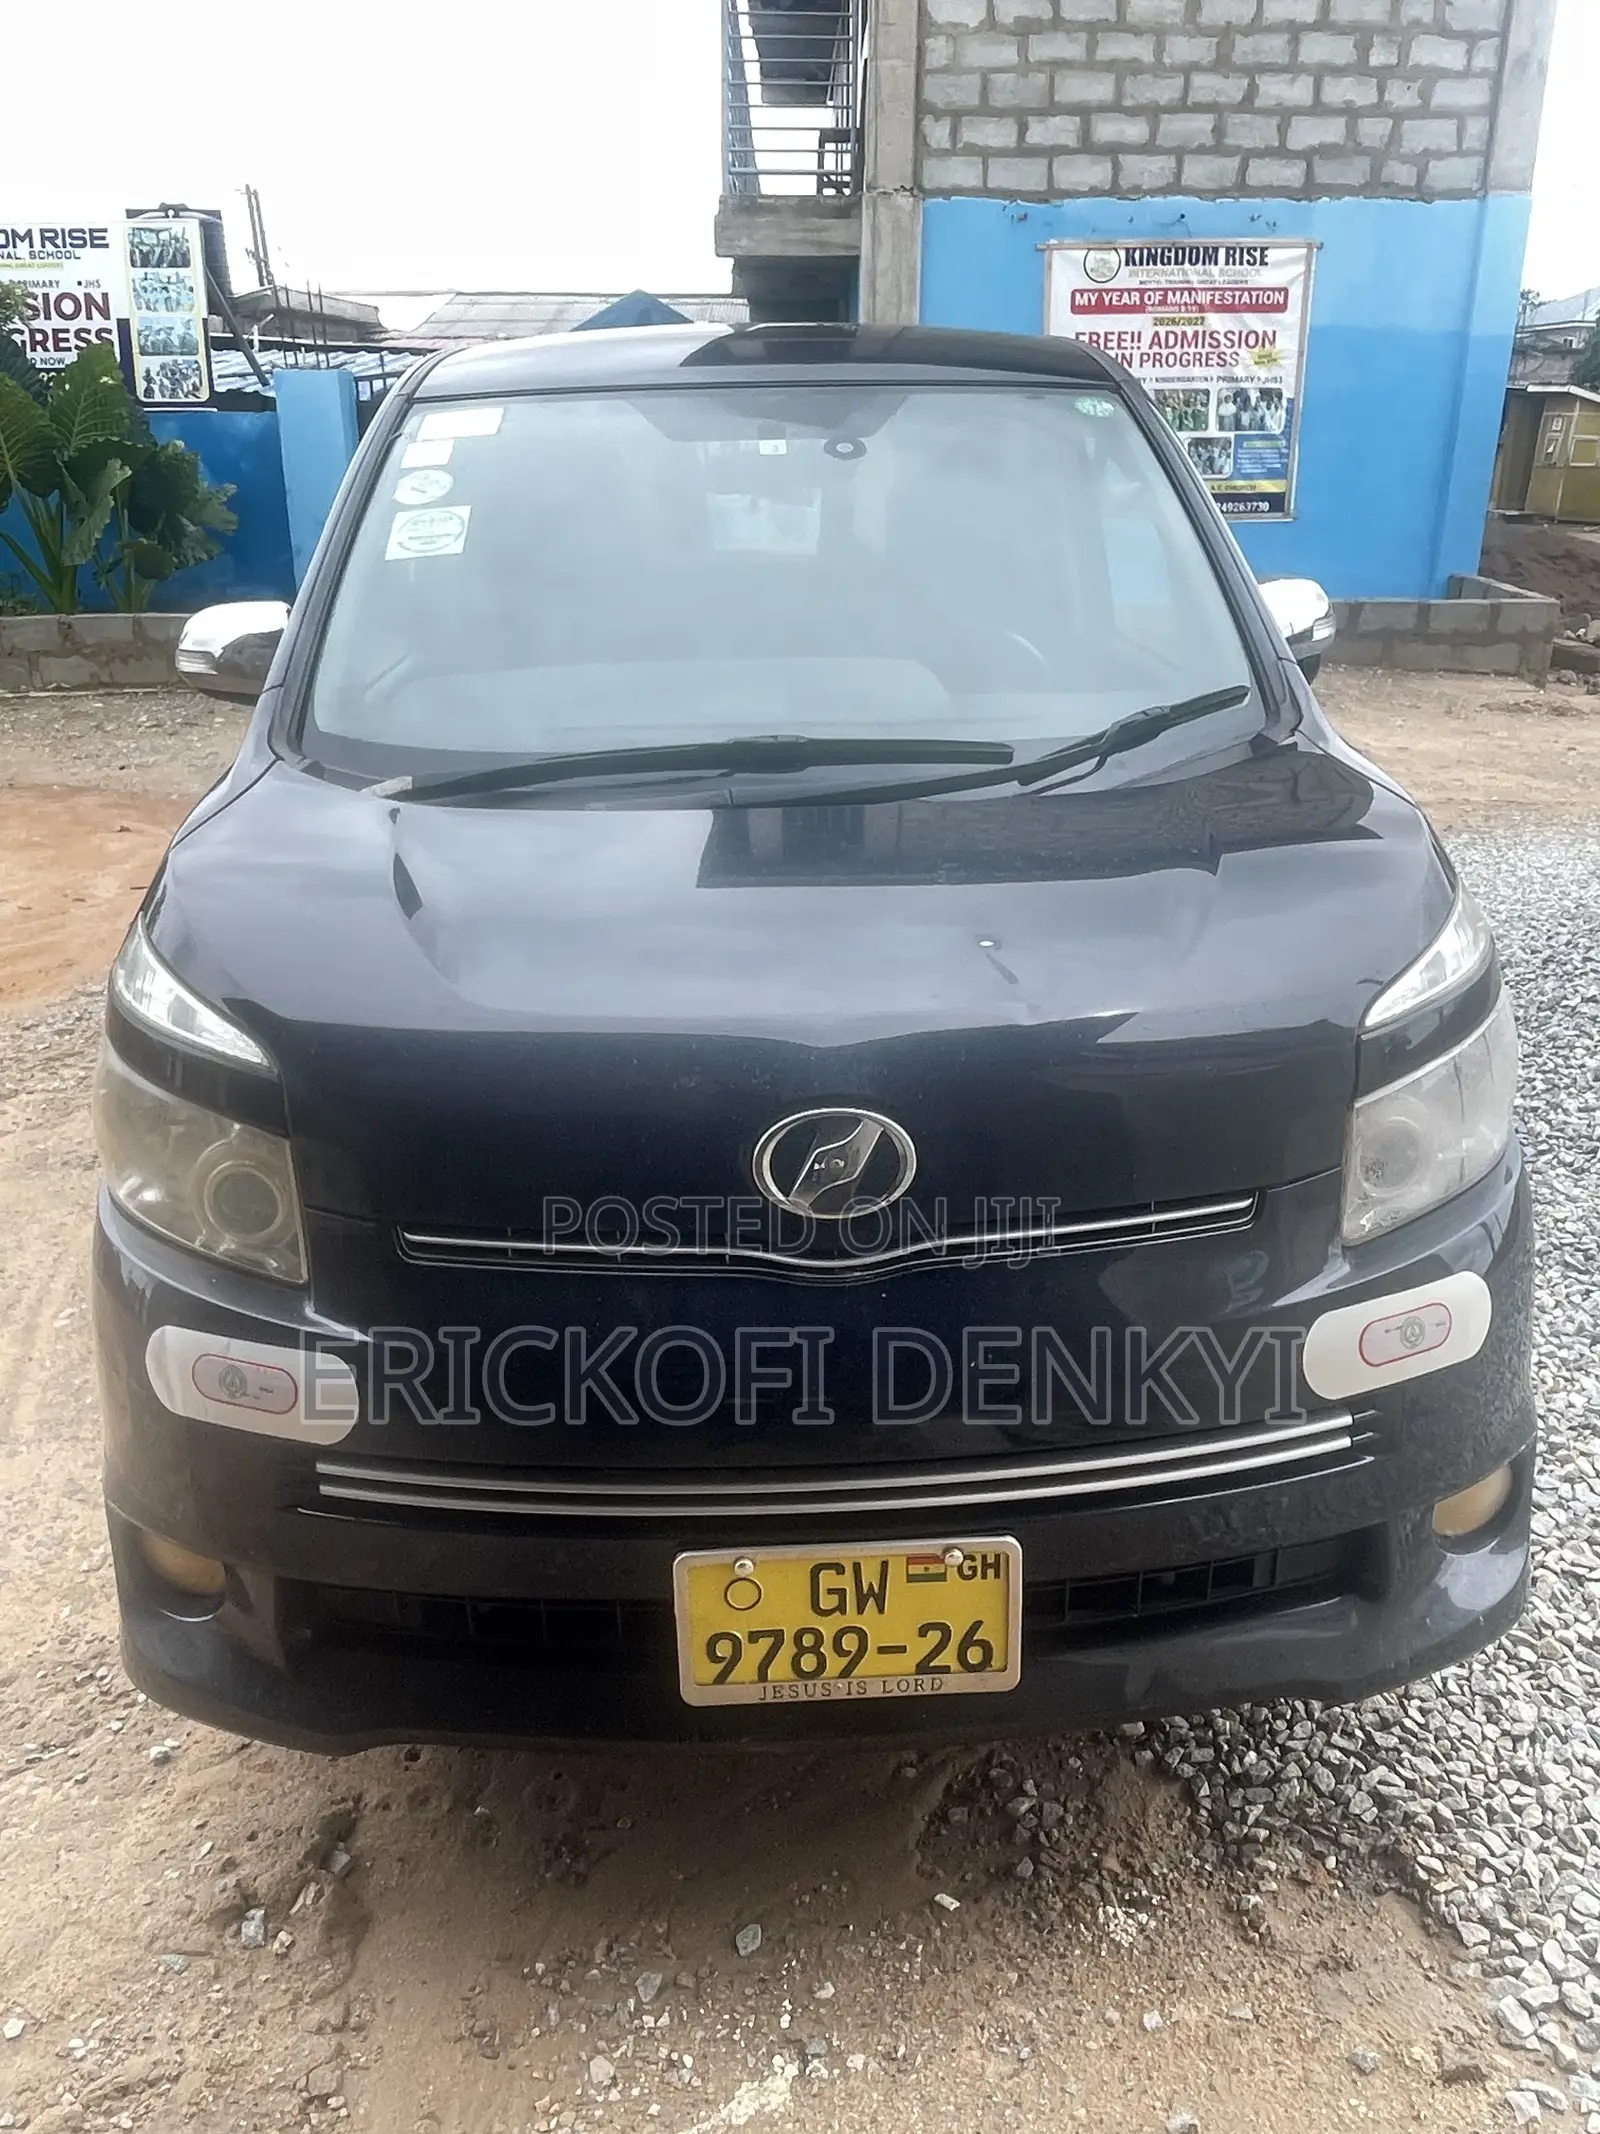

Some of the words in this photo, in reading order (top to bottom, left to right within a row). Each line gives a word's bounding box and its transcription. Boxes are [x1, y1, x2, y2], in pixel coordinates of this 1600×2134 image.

[39, 228, 110, 249] RISE
[29, 250, 81, 260] SCHOOL
[1124, 246, 1219, 267] KINGDOM
[1225, 246, 1270, 267] RISE
[1128, 268, 1214, 278] INTERNATIONAL
[1219, 267, 1261, 278] SCHOOL
[83, 279, 101, 289] JHS
[1075, 293, 1099, 306] MY
[1102, 292, 1141, 305] YEAR
[1144, 291, 1163, 305] OF
[1167, 290, 1285, 306] MANIFESTATION
[1075, 331, 1142, 350] FREE!!
[1148, 330, 1277, 350] ADMISSION
[40, 357, 66, 366] NOW
[1139, 351, 1240, 368] PROGRESS
[1216, 376, 1255, 384] PRIMARY
[809, 1559, 889, 1617] GW
[957, 1554, 1001, 1581] GH
[705, 1620, 995, 1685] 9789-26
[758, 1681, 832, 1701] JESUS
[846, 1681, 868, 1696] IS
[882, 1677, 944, 1694] LORD
